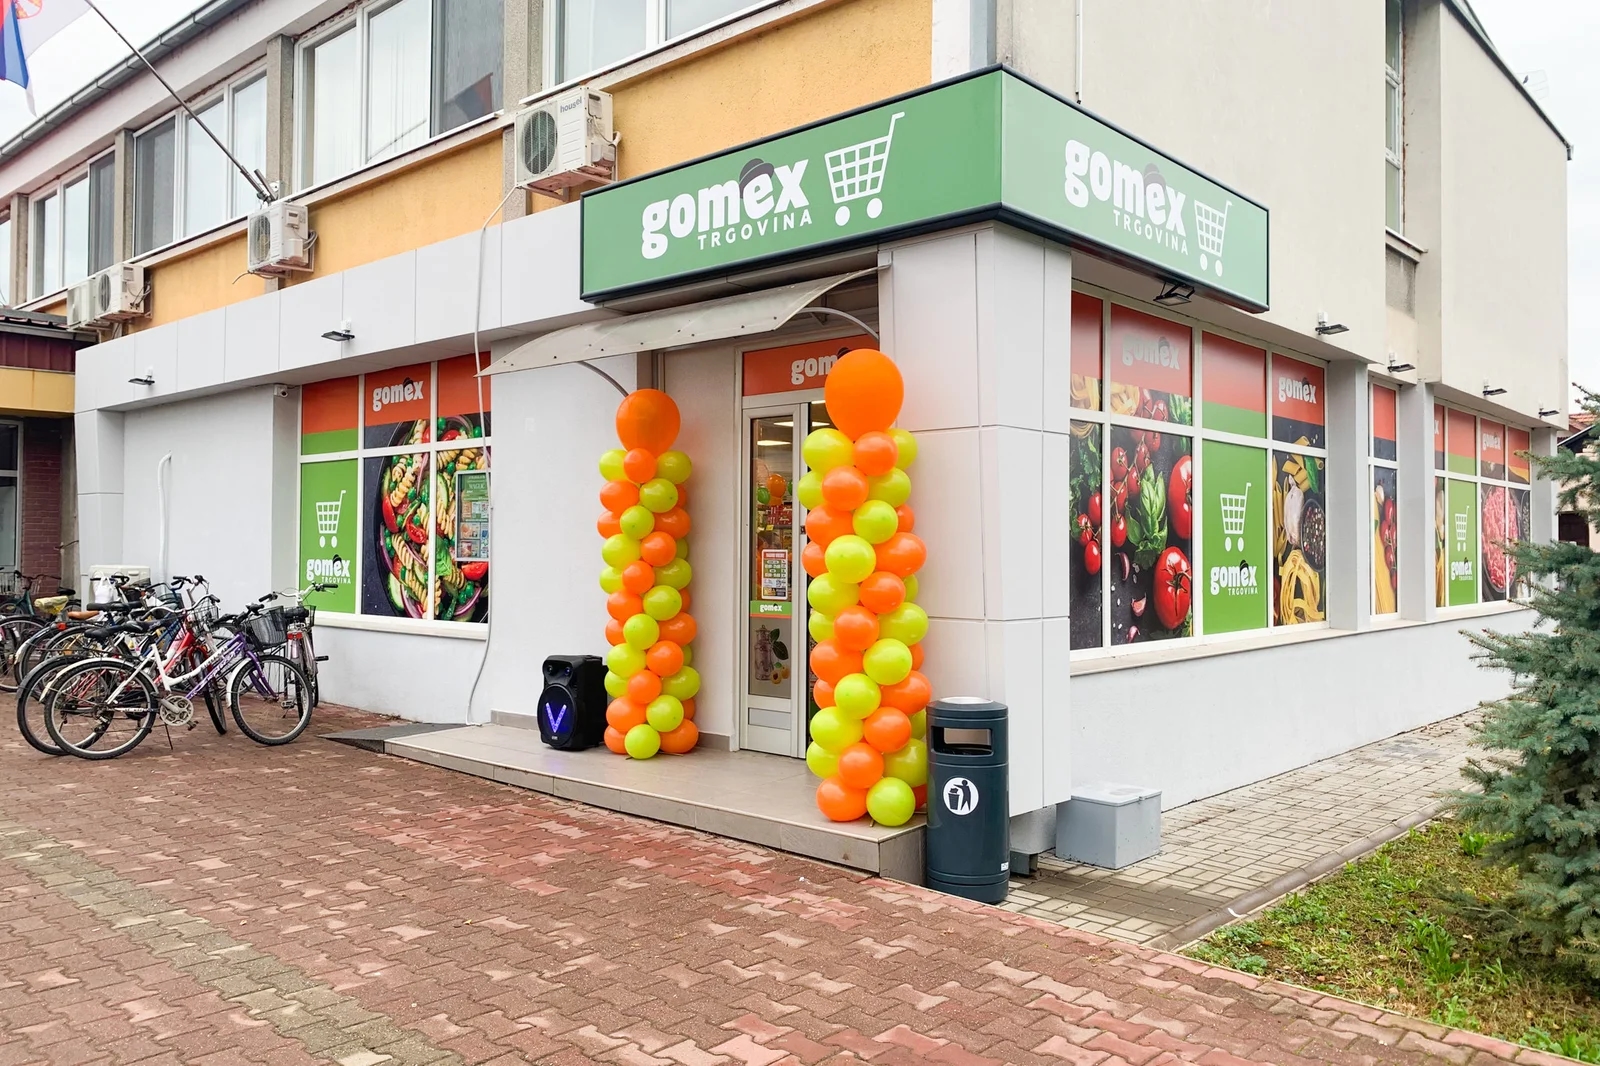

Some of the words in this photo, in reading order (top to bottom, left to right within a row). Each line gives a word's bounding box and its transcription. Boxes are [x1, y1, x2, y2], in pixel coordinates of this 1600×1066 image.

[1064, 139, 1187, 237] gomex
[641, 159, 809, 260] gomex
[697, 209, 813, 250] TRGOVINA
[1112, 209, 1189, 256] TRGOVINA
[1122, 335, 1180, 370] gomex
[791, 354, 838, 385] gom
[372, 380, 424, 412] gomex
[1278, 376, 1317, 404] gomex
[306, 558, 351, 581] gomex
[321, 576, 352, 584] TRGOVINA
[1210, 565, 1258, 596] gomex
[1227, 586, 1259, 596] TRGOVINA
[759, 603, 783, 613] gomex
[545, 702, 568, 733] V
